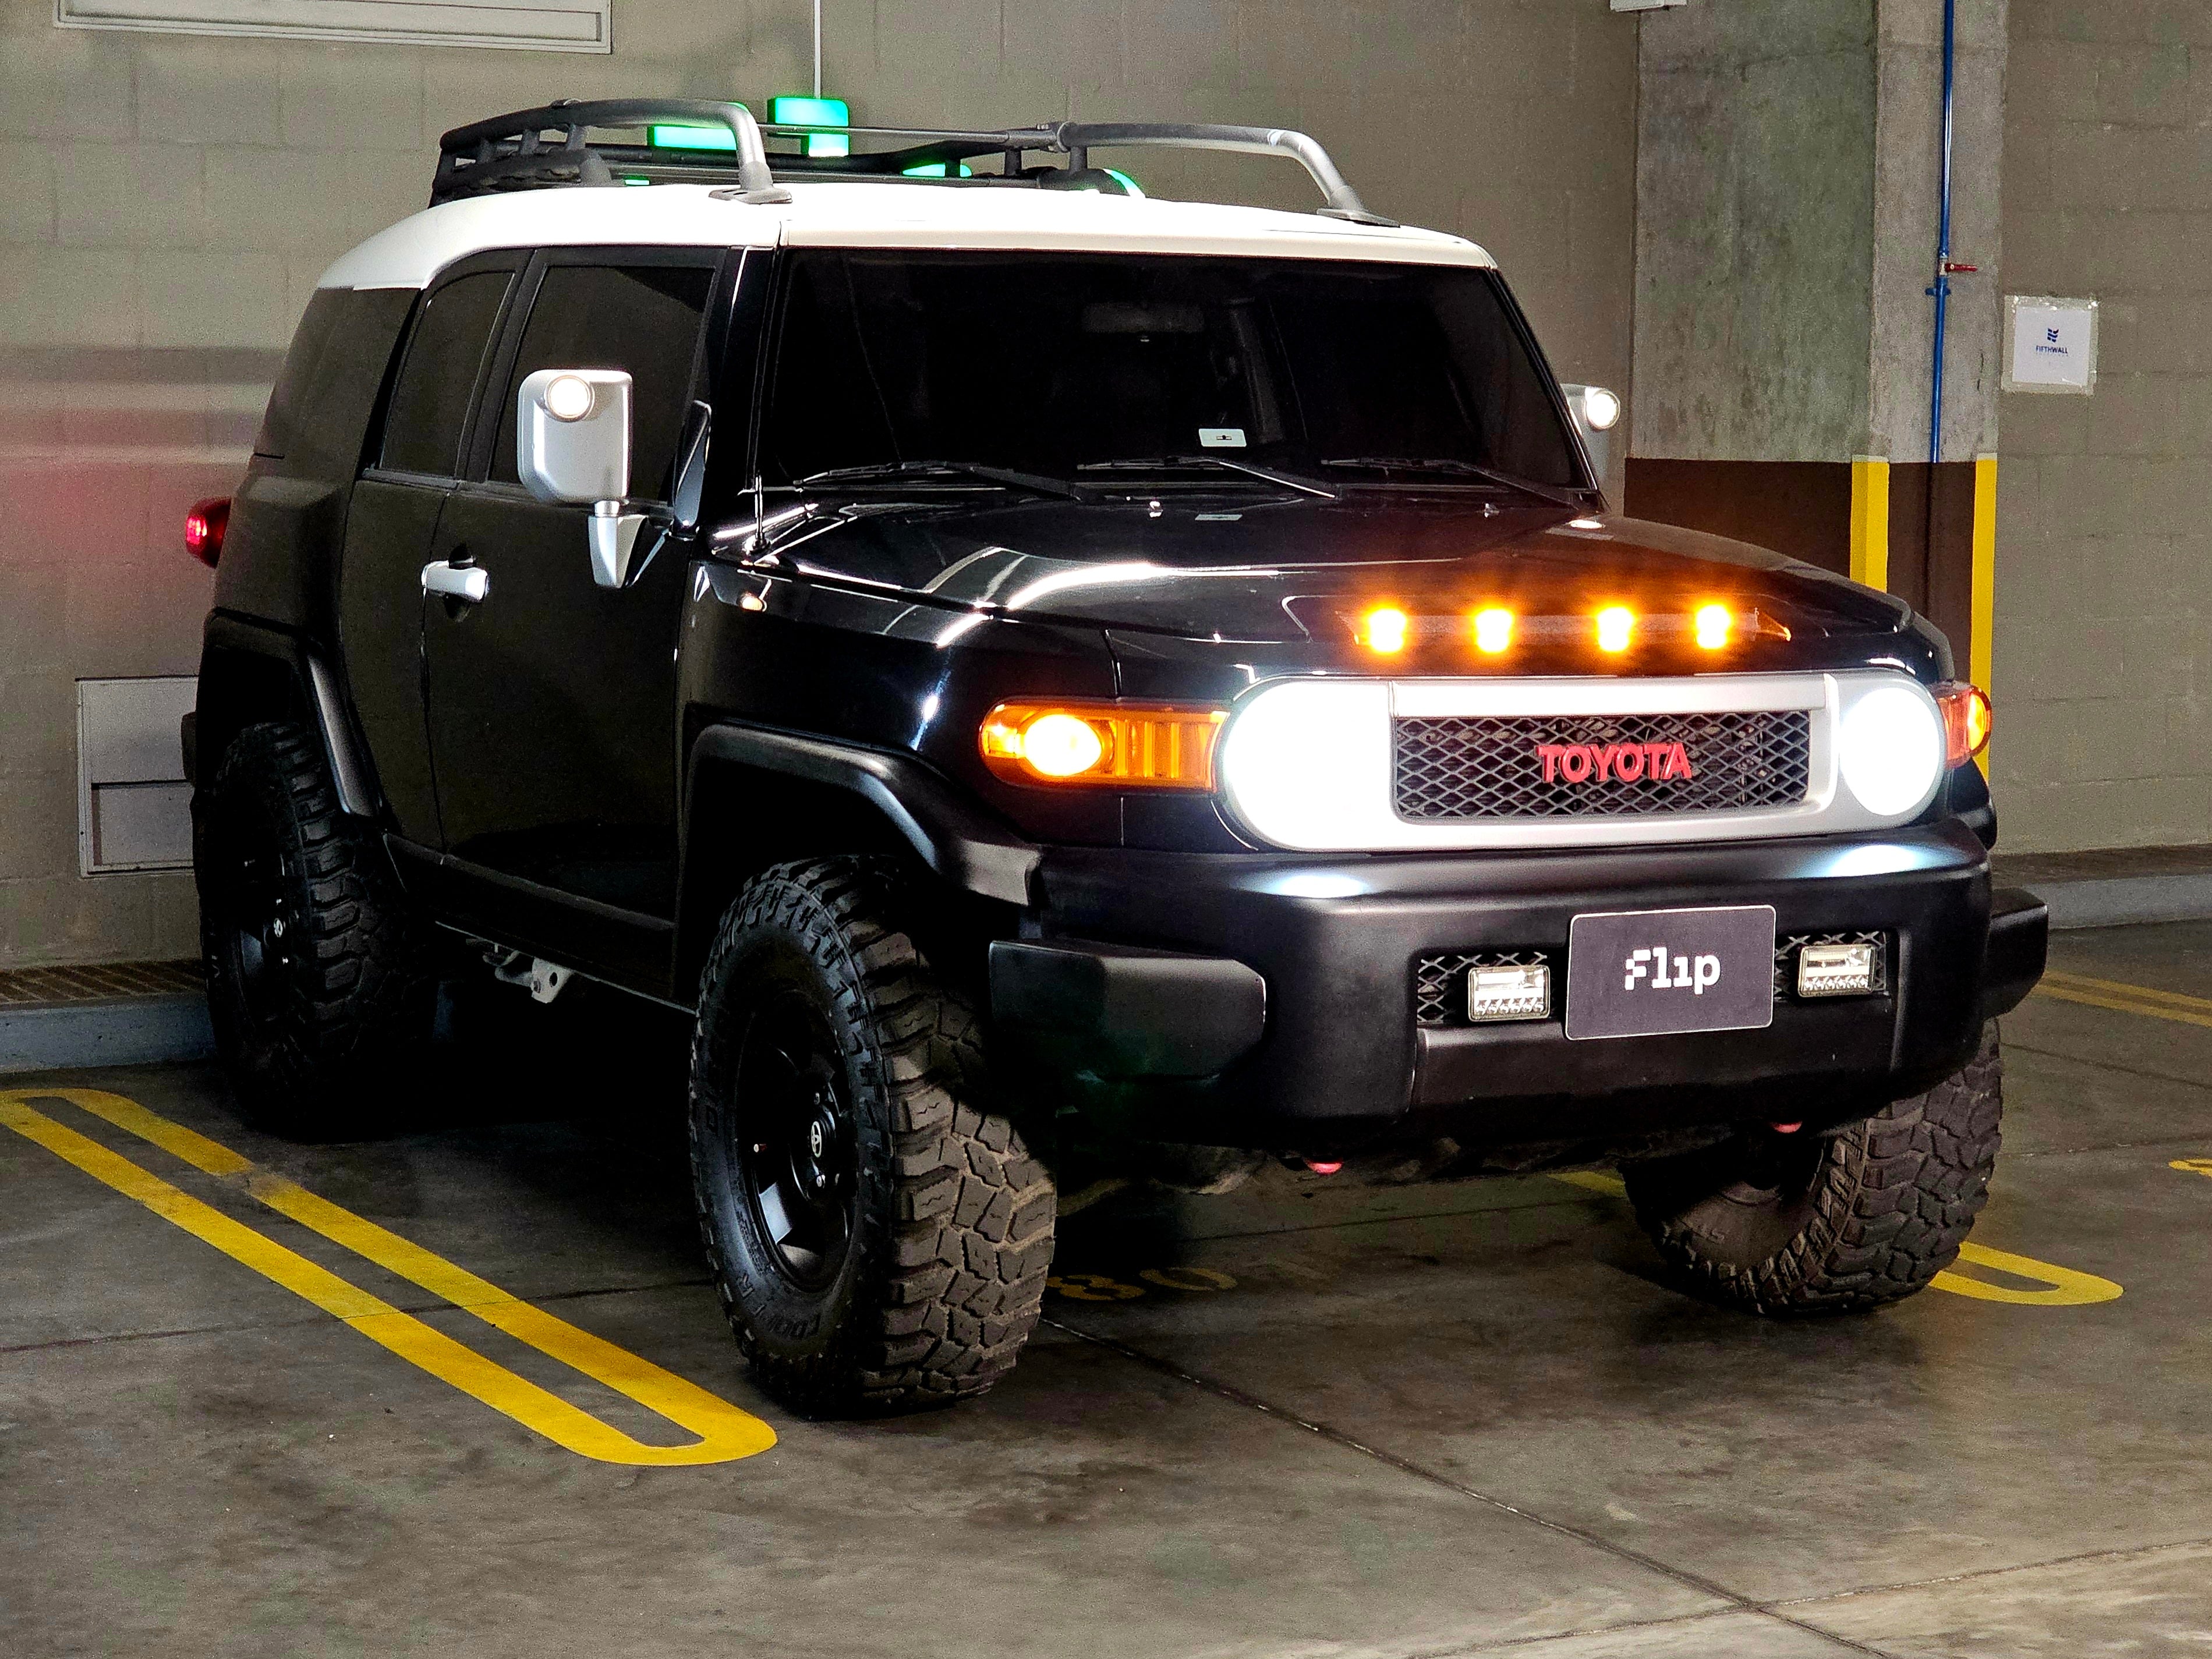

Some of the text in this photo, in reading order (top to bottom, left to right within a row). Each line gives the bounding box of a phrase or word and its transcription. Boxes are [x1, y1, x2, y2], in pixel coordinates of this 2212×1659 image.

[2036, 345, 2068, 354] FIFTHWALL
[1535, 742, 1692, 783] TOYOTA
[1625, 947, 1721, 995] Flip
